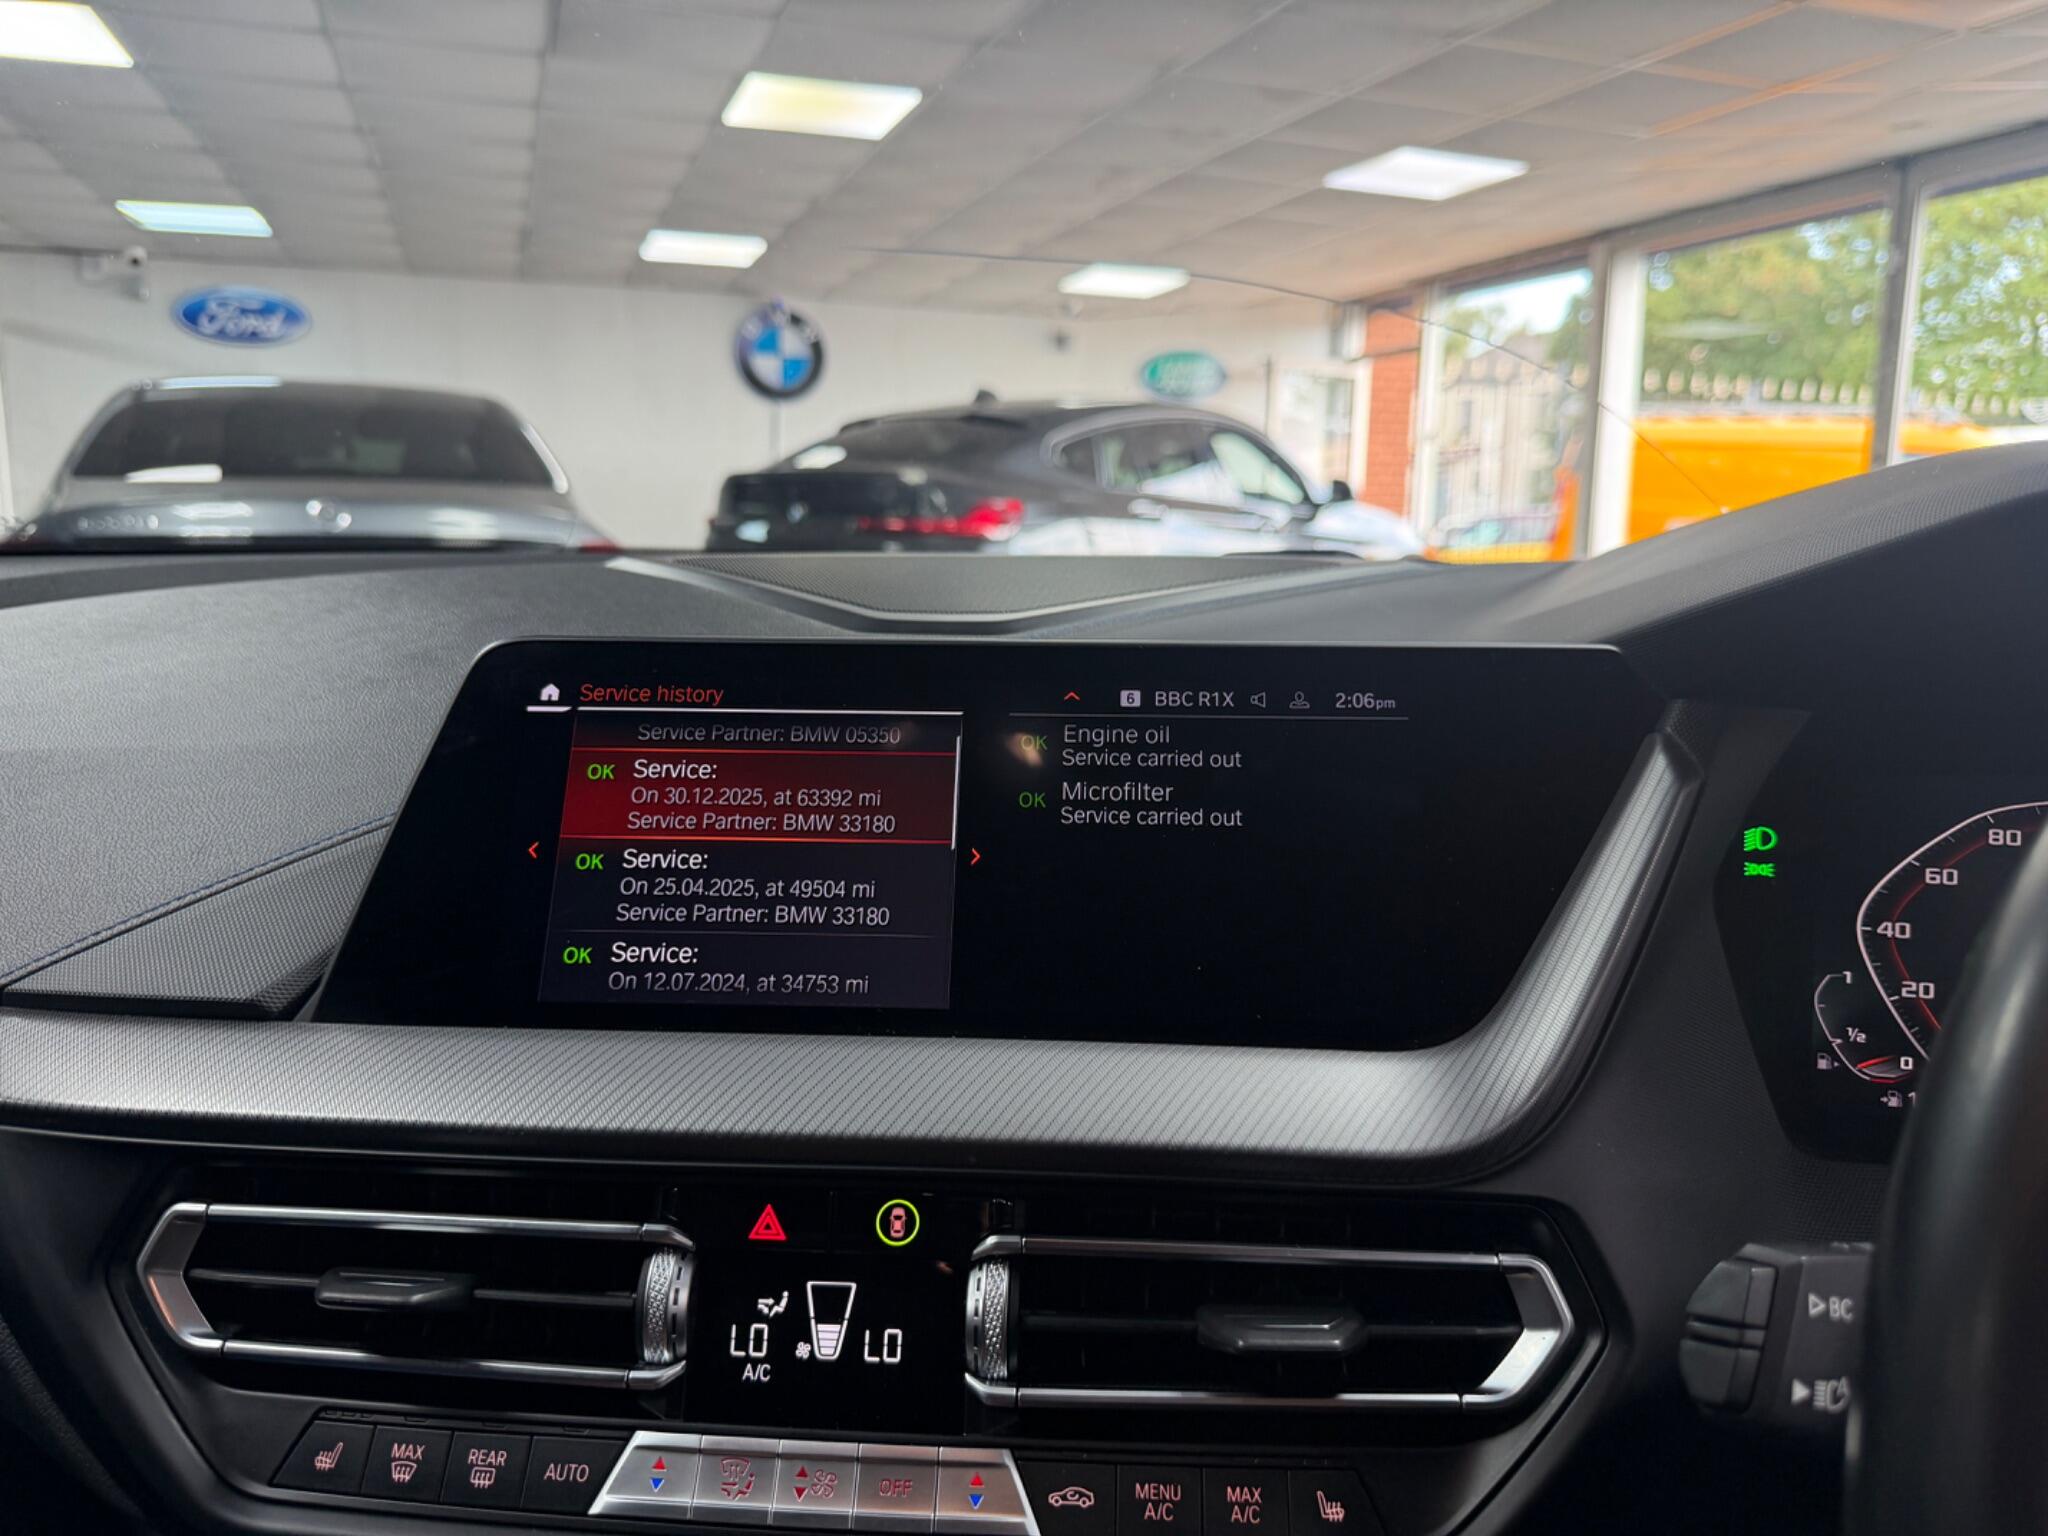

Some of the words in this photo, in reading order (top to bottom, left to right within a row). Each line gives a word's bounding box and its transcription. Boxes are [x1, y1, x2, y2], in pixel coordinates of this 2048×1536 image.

[580, 684, 652, 702] Service
[657, 686, 724, 706] history
[1126, 693, 1135, 705] 6
[1155, 691, 1193, 707] BBC
[1199, 692, 1234, 707] R1X
[1335, 693, 1396, 710] 2:06pm
[638, 724, 706, 741] Service
[711, 725, 784, 743] Partner:
[790, 726, 839, 743] BMW
[845, 727, 901, 744] 05350
[1020, 735, 1048, 750] OK
[1064, 725, 1138, 747] Engine
[1145, 726, 1170, 743] oil
[1062, 750, 1131, 767] Service
[1137, 751, 1202, 768] carried
[1210, 753, 1242, 768] out
[587, 764, 615, 779] OK
[633, 760, 717, 779] Service:
[631, 788, 659, 805] On
[664, 788, 768, 807] 30.12.2025,
[773, 792, 793, 806] at
[797, 790, 853, 807] 63392
[858, 790, 881, 807] mi
[1019, 793, 1047, 808] OK
[1062, 783, 1173, 802] Microfilter
[627, 812, 696, 830] Service
[704, 813, 777, 831] Partner:
[783, 815, 834, 832] BMW
[839, 816, 896, 833] 33180
[1061, 807, 1131, 824] Service
[1136, 809, 1202, 825] carried
[1210, 811, 1243, 826] out
[1988, 829, 2022, 846] 80
[575, 854, 604, 870] OK
[622, 849, 708, 869] Service:
[1925, 868, 1958, 885] 60
[620, 878, 648, 895] On
[653, 878, 759, 899] 25.04.2025,
[766, 883, 785, 897] at
[789, 881, 846, 898] 49504
[852, 881, 875, 898] mi
[616, 904, 687, 922] Service
[693, 905, 769, 923] Partner:
[775, 906, 827, 924] BMW
[832, 908, 890, 925] 33180
[1876, 921, 1911, 939] 40
[563, 947, 592, 964] OK
[611, 942, 698, 962] Service:
[608, 972, 637, 990] On
[643, 972, 749, 993] 12.07.2024,
[756, 977, 776, 992] at
[781, 976, 839, 993] 34753
[845, 976, 869, 994] mi
[1843, 971, 1852, 984] 1
[1901, 981, 1935, 999] 20
[1900, 1057, 1913, 1070] 0
[1829, 1296, 1853, 1322] BC
[742, 1363, 771, 1382] A/C
[391, 1443, 425, 1461] MAX
[468, 1449, 507, 1466] REAR
[544, 1463, 589, 1482] AUTO
[879, 1478, 913, 1497] OFF
[1135, 1482, 1181, 1501] MENU
[1227, 1486, 1262, 1504] MAX
[1144, 1502, 1174, 1521] A/C
[1231, 1504, 1261, 1523] A/C
